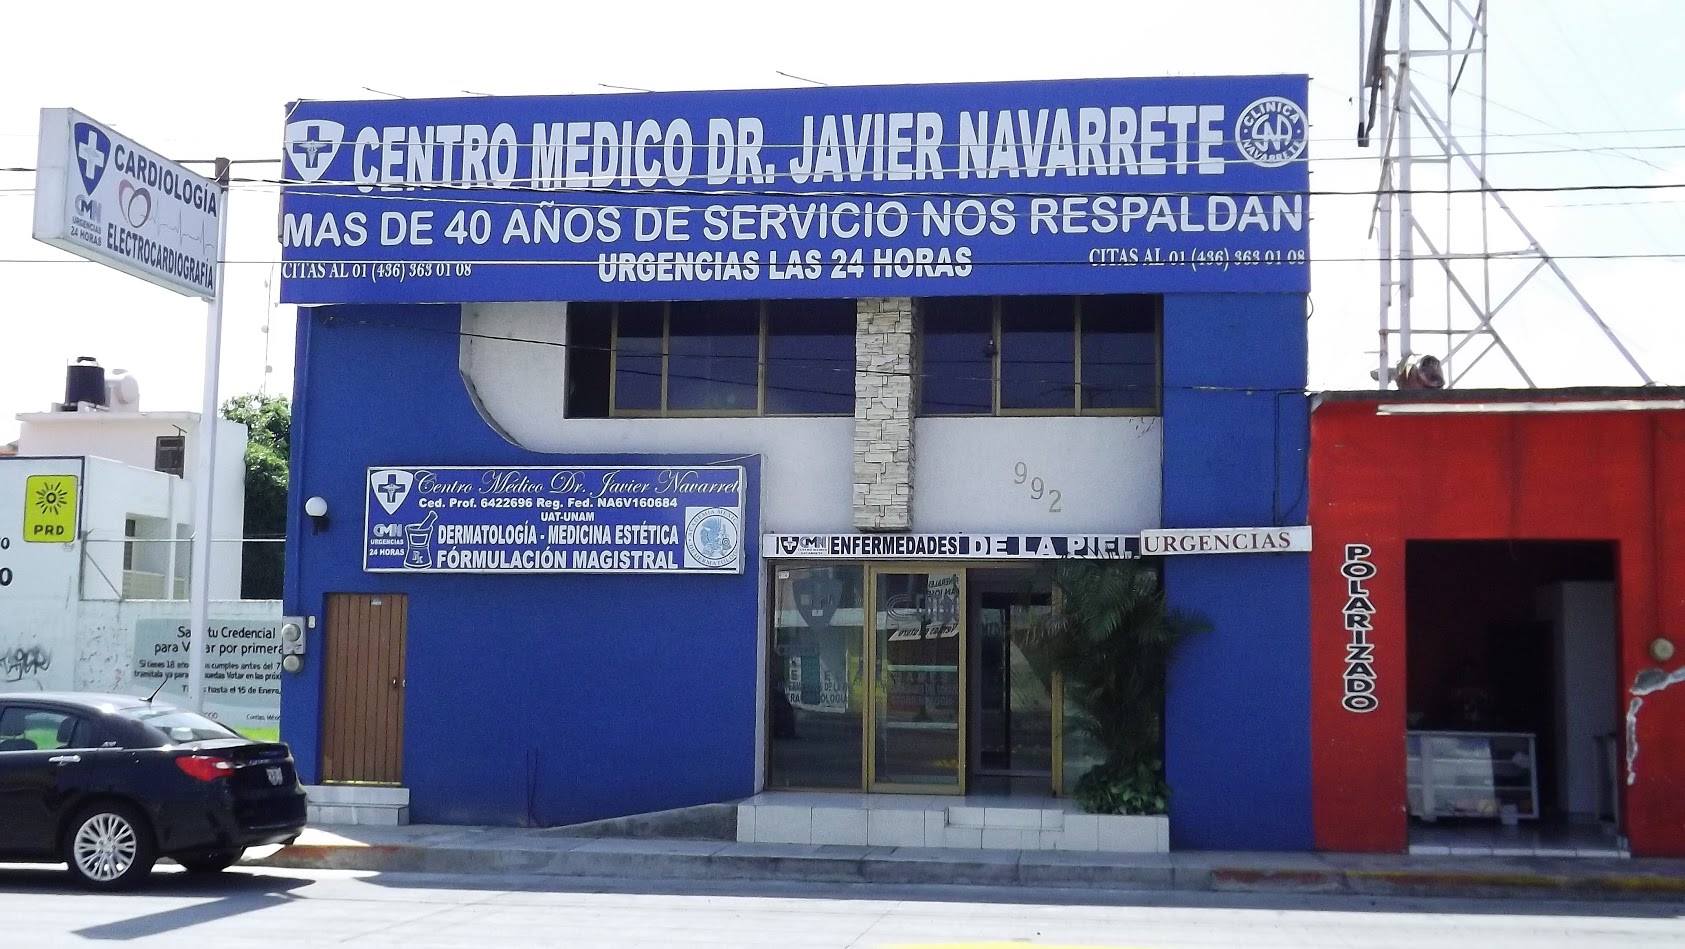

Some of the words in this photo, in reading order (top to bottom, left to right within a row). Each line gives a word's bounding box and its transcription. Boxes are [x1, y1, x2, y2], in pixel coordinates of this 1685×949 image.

[1243, 101, 1300, 126] CLINICA
[353, 122, 518, 193] CENTRO
[531, 118, 693, 190] MEDICO
[707, 117, 775, 186] DR.
[789, 112, 944, 184] JAVIER
[959, 105, 1225, 179] NAVARRETE
[114, 144, 217, 217] CARDIOLOGÍA
[283, 211, 367, 248] MAS
[381, 210, 433, 246] DE
[444, 209, 492, 246] 40
[502, 200, 621, 244] AÑOS
[636, 206, 690, 242] DE
[703, 200, 908, 241] SERVICIO
[922, 199, 1016, 237] NOS
[1031, 196, 1302, 235] RESPALDAN
[80, 229, 102, 246] HORAS
[107, 222, 213, 290] ELECTROCARDIOGRAFÍA
[598, 250, 760, 282] URGENCIAS
[768, 249, 822, 280] LAS
[830, 248, 865, 278] 24
[873, 246, 973, 278] HORAS
[1089, 248, 1139, 266] CITAS
[1142, 247, 1165, 266] AL
[1168, 250, 1185, 266] 01
[1264, 249, 1282, 265] 01
[1287, 249, 1305, 265] 08
[282, 262, 326, 279] CITAS
[329, 262, 349, 278] AL
[352, 263, 367, 278] 01
[409, 263, 432, 277] 363
[436, 263, 451, 277] 01
[456, 263, 472, 277] 08
[414, 469, 473, 494] Centro
[478, 469, 544, 494] Médico
[550, 470, 586, 494] Dr.
[589, 469, 650, 499] Javier
[1014, 461, 1062, 513] 992
[418, 498, 446, 508] Ced.
[450, 497, 477, 508] Prof.
[480, 498, 533, 508] 6422696
[536, 498, 564, 510] Reg.
[567, 498, 593, 508] Fed.
[540, 511, 595, 522] UAT-UNAM
[34, 524, 65, 536] PRD
[437, 520, 537, 544] DERMATOLOGÍA
[548, 523, 611, 544] MEDICINA
[615, 520, 679, 544] ESTÉTICA
[369, 548, 378, 556] 24
[380, 548, 405, 556] HORAS
[831, 536, 958, 555] ENFERMEDADES
[969, 536, 1008, 556] DE
[1019, 536, 1057, 557] LA
[1144, 531, 1292, 553] URGENCIAS
[436, 545, 567, 569] FÓRMULACIÓN
[572, 549, 679, 569] MAGISTRAL
[208, 627, 218, 638] tu
[221, 627, 275, 639] Credencial
[1341, 544, 1378, 712] POLARIZADO
[154, 643, 178, 655] para
[219, 644, 237, 657] por
